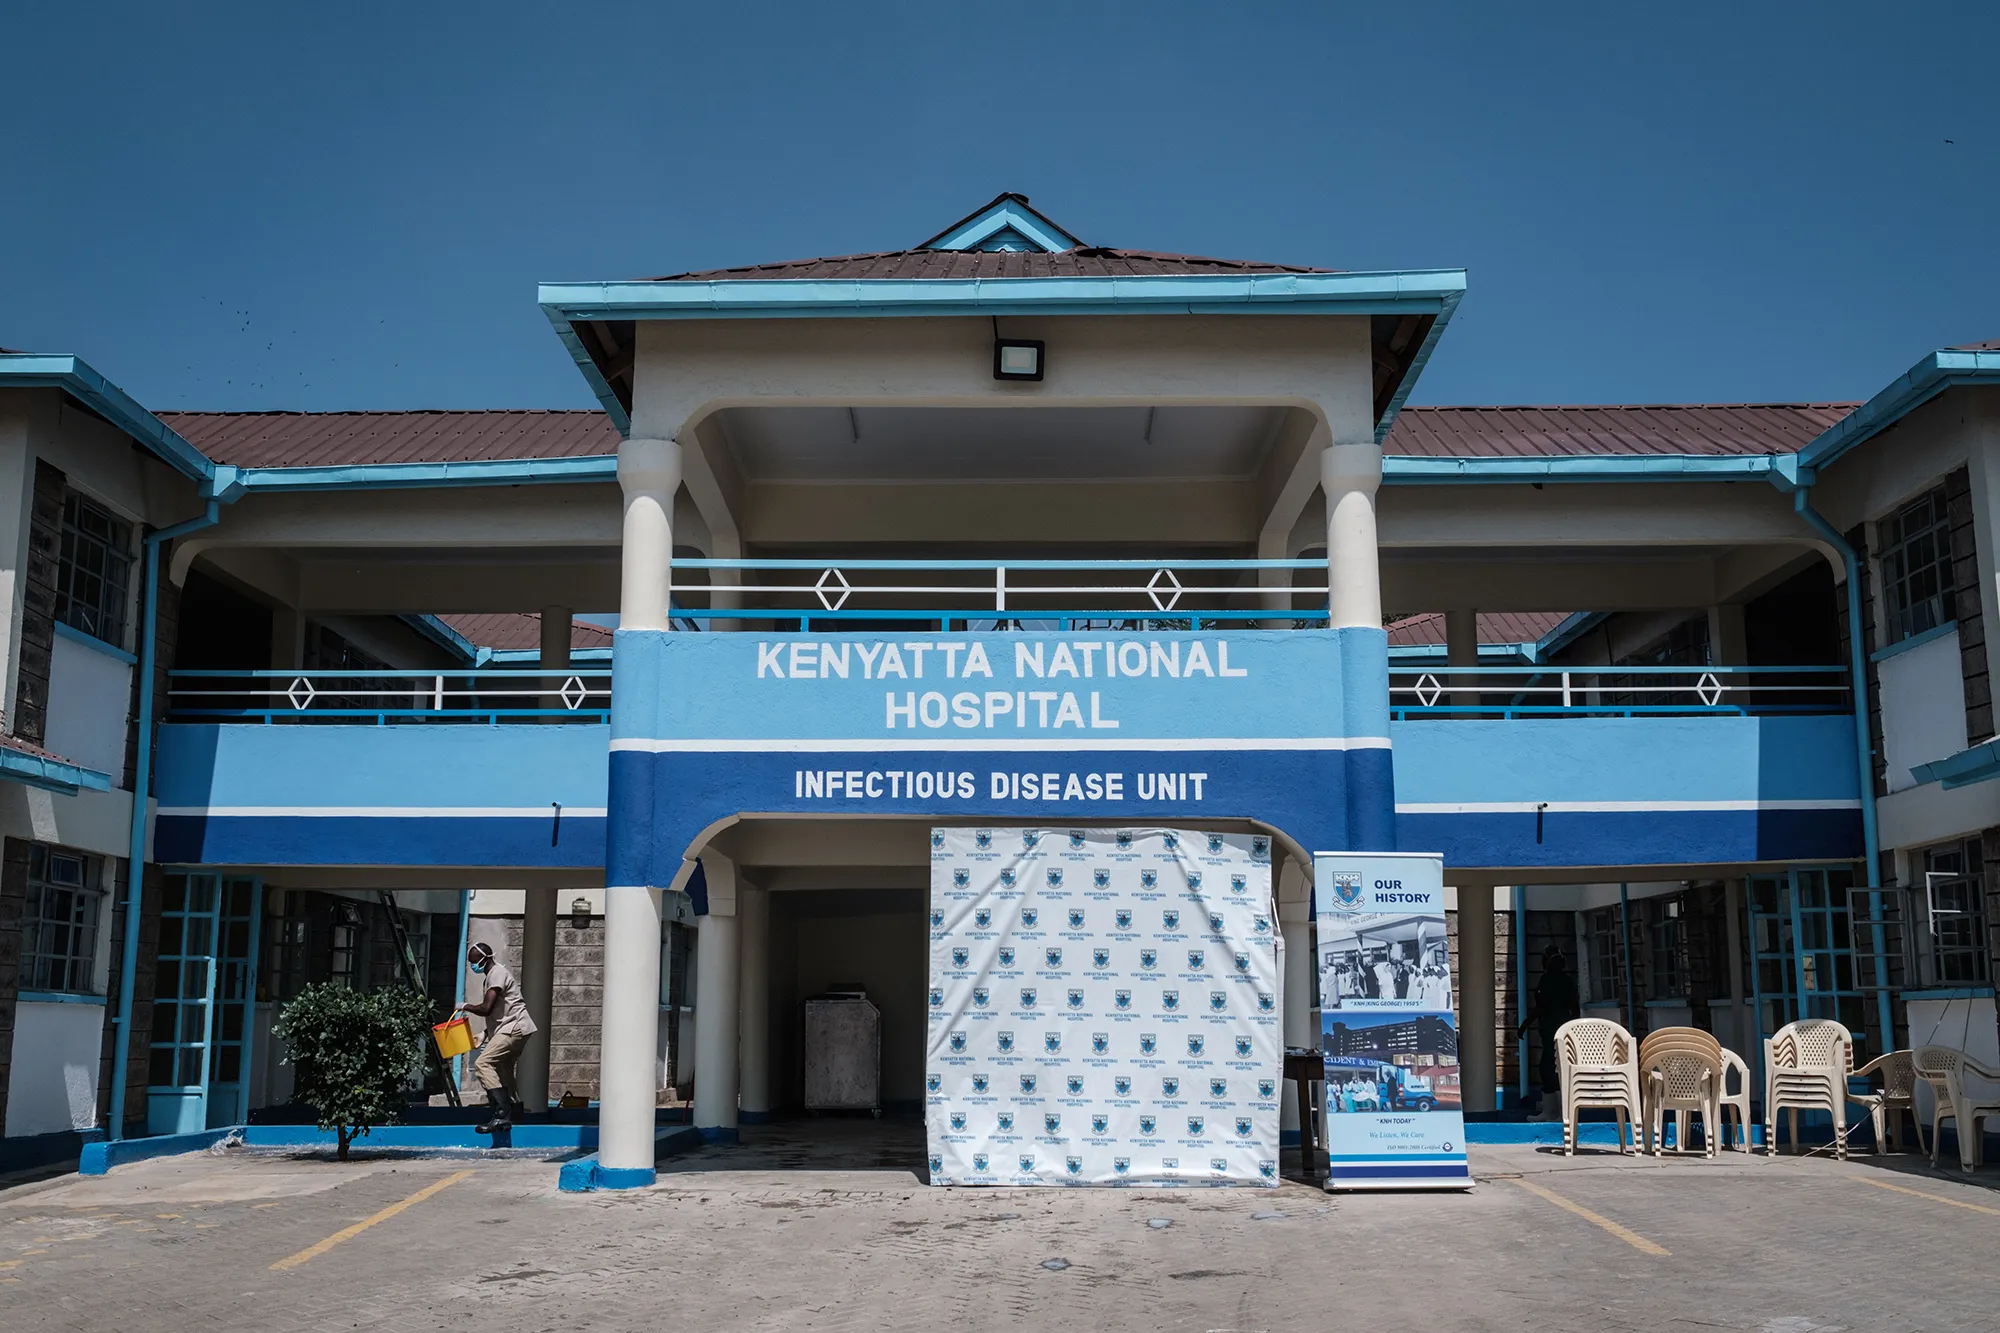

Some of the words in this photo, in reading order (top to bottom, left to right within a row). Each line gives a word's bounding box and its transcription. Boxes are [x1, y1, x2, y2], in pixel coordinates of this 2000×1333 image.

[757, 641, 994, 679] KENYATTA
[1015, 641, 1247, 678] NATIONAL
[886, 691, 1119, 728] HOSPITAL
[796, 771, 975, 799] INFECTIOUS
[991, 772, 1123, 800] DISEASE
[1138, 773, 1208, 800] UNIT
[1374, 880, 1402, 889] OUR
[1375, 893, 1430, 903] HISTORY
